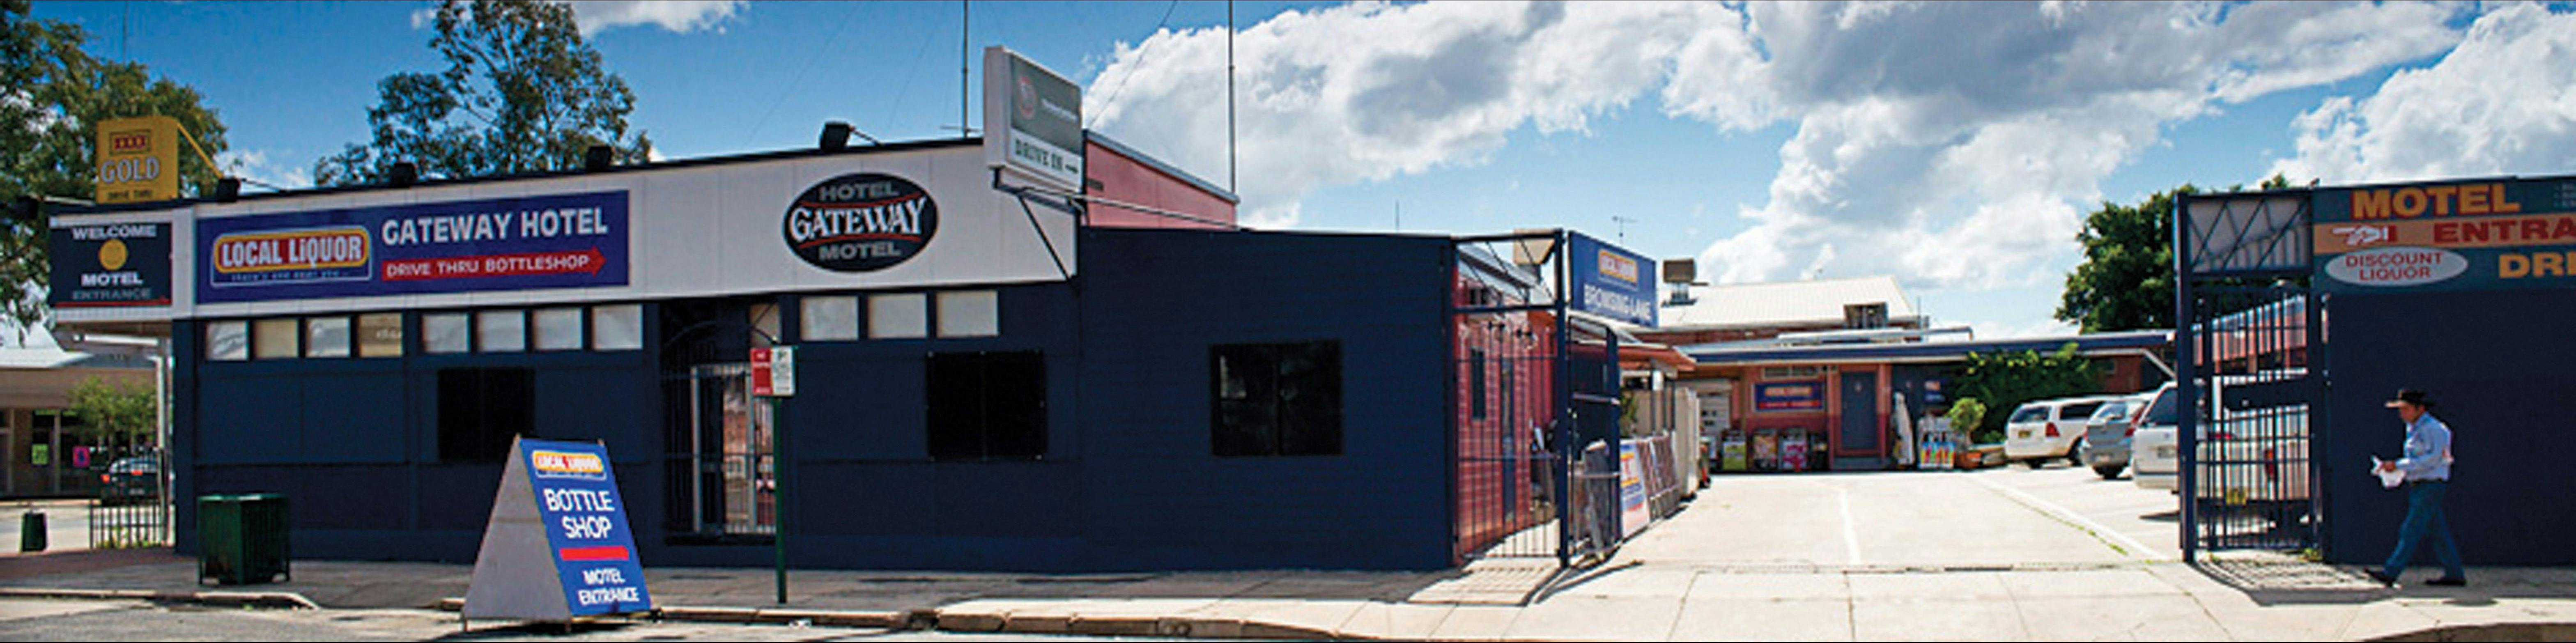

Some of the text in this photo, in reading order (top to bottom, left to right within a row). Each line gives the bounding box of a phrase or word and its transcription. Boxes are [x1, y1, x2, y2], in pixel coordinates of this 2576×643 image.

[101, 156, 159, 184] GOLD
[819, 182, 899, 200] HOTEL
[2351, 182, 2521, 219] MOTEL
[382, 206, 608, 245] GATEWAY HOTEL
[790, 196, 927, 242] GATEWAY
[72, 225, 156, 240] WELCOME
[2432, 217, 2576, 243] ENTRA
[222, 241, 282, 267] LOCAL
[818, 242, 901, 259] MOTEL
[2346, 252, 2443, 267] DISCOUNT
[387, 254, 590, 277] DRIVE THRU BOTTLESHOP
[2359, 267, 2430, 281] LIQUOR
[81, 271, 143, 286] MOTEL
[73, 288, 152, 300] ENTRANCE
[543, 488, 615, 511] BOTTLE
[562, 516, 612, 539] SHOP
[583, 567, 625, 585] MOTEL
[578, 587, 640, 606] ENTRANCE
